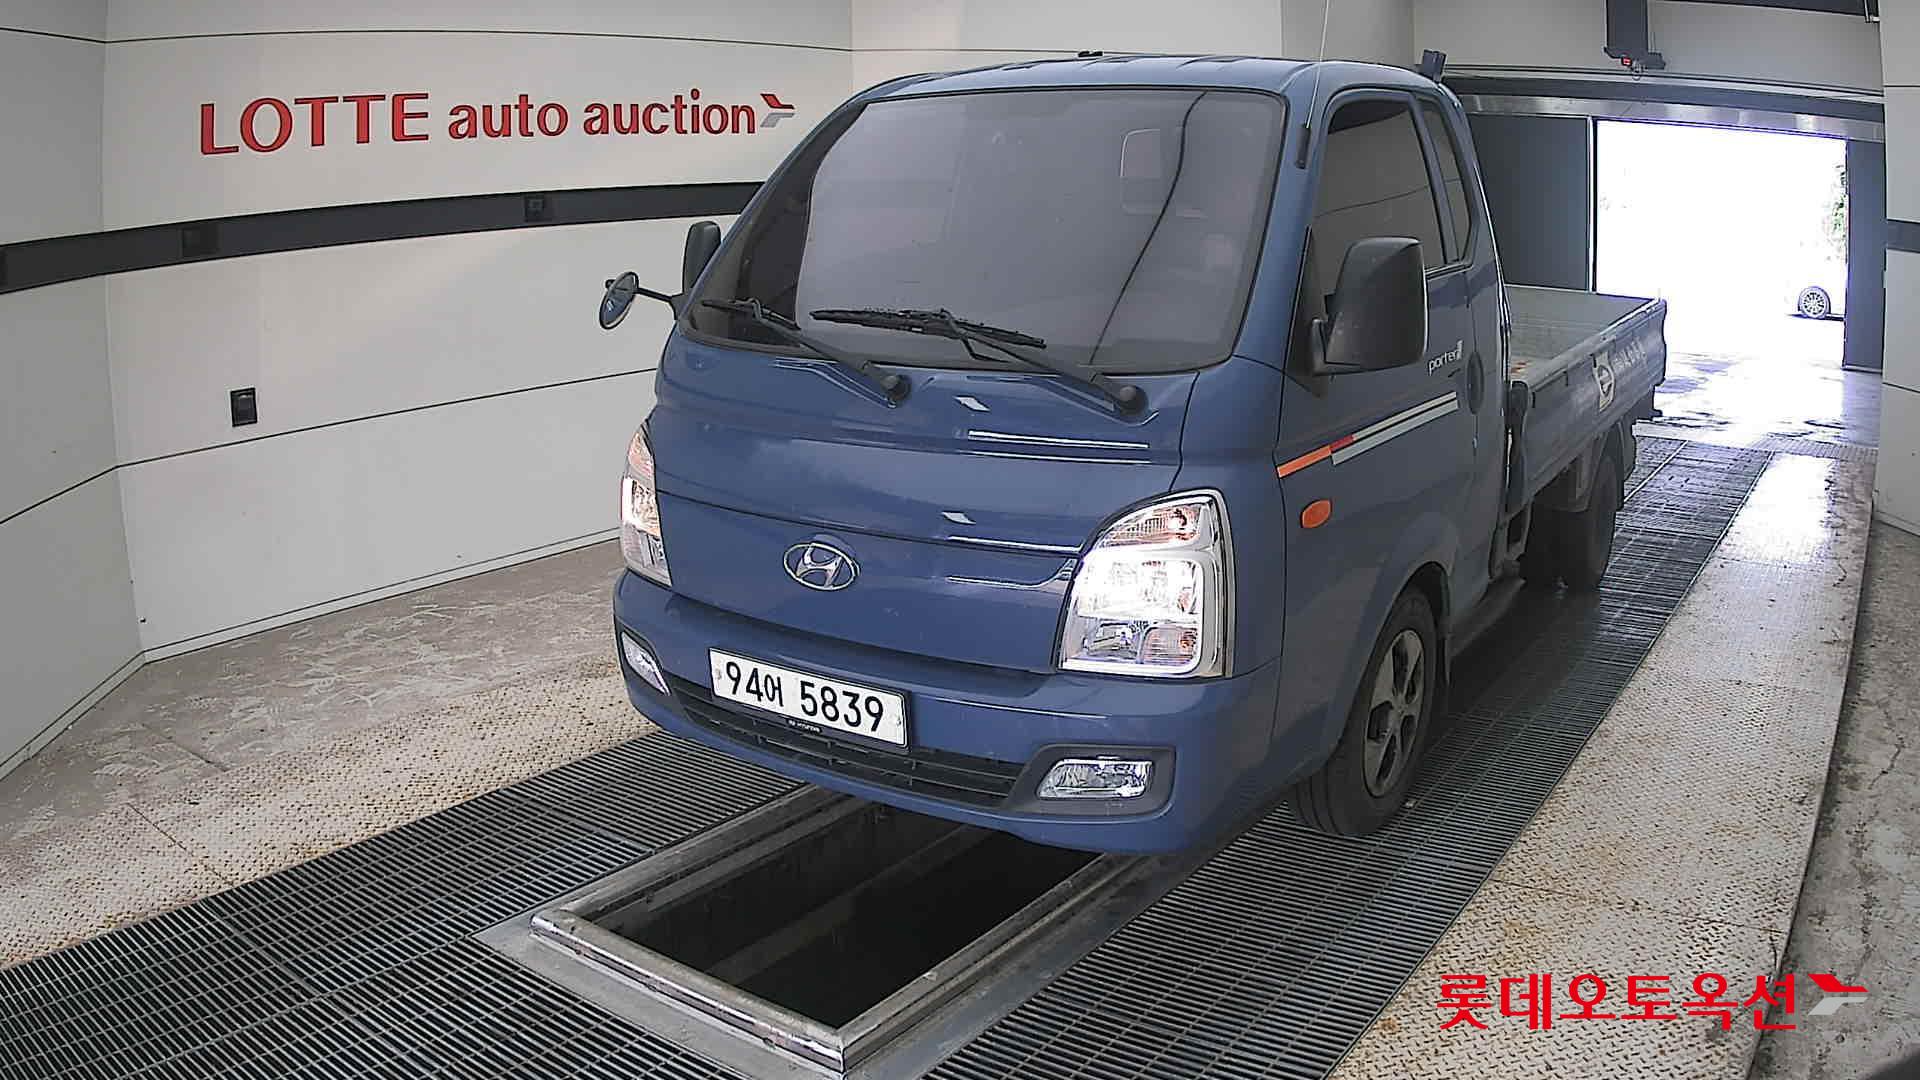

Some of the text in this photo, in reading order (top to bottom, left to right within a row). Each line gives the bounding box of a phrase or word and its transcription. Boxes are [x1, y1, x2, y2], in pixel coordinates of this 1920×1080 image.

[200, 88, 757, 155] LOTTE auto auction
[726, 661, 884, 732] 94어 5839
